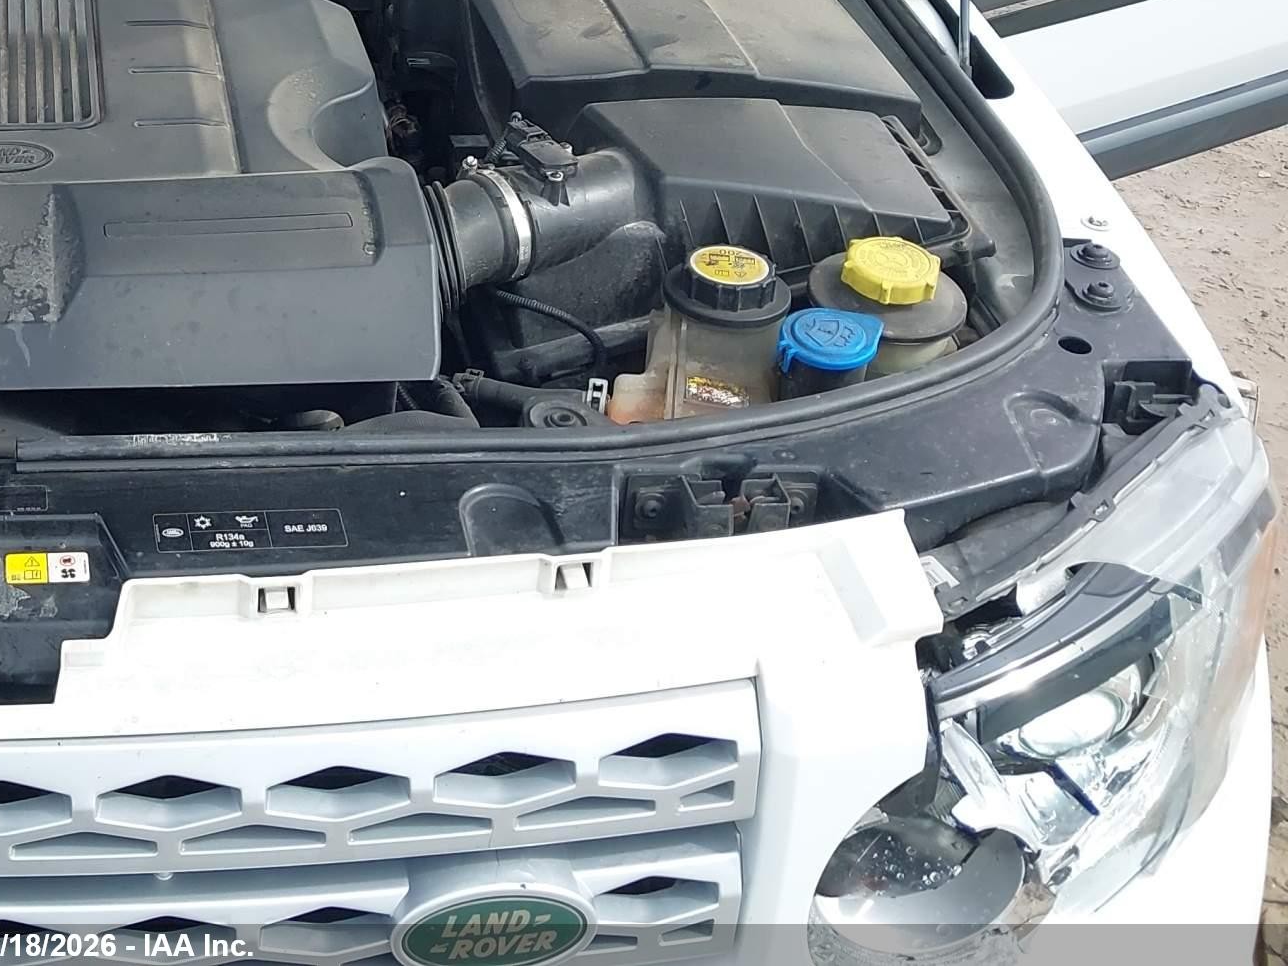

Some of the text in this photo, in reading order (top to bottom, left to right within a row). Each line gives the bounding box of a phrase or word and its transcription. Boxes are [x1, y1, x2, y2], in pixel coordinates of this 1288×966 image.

[215, 533, 245, 541] R134a
[284, 524, 304, 533] SAE
[441, 909, 531, 938] LAND
[448, 930, 558, 960] ROVER
